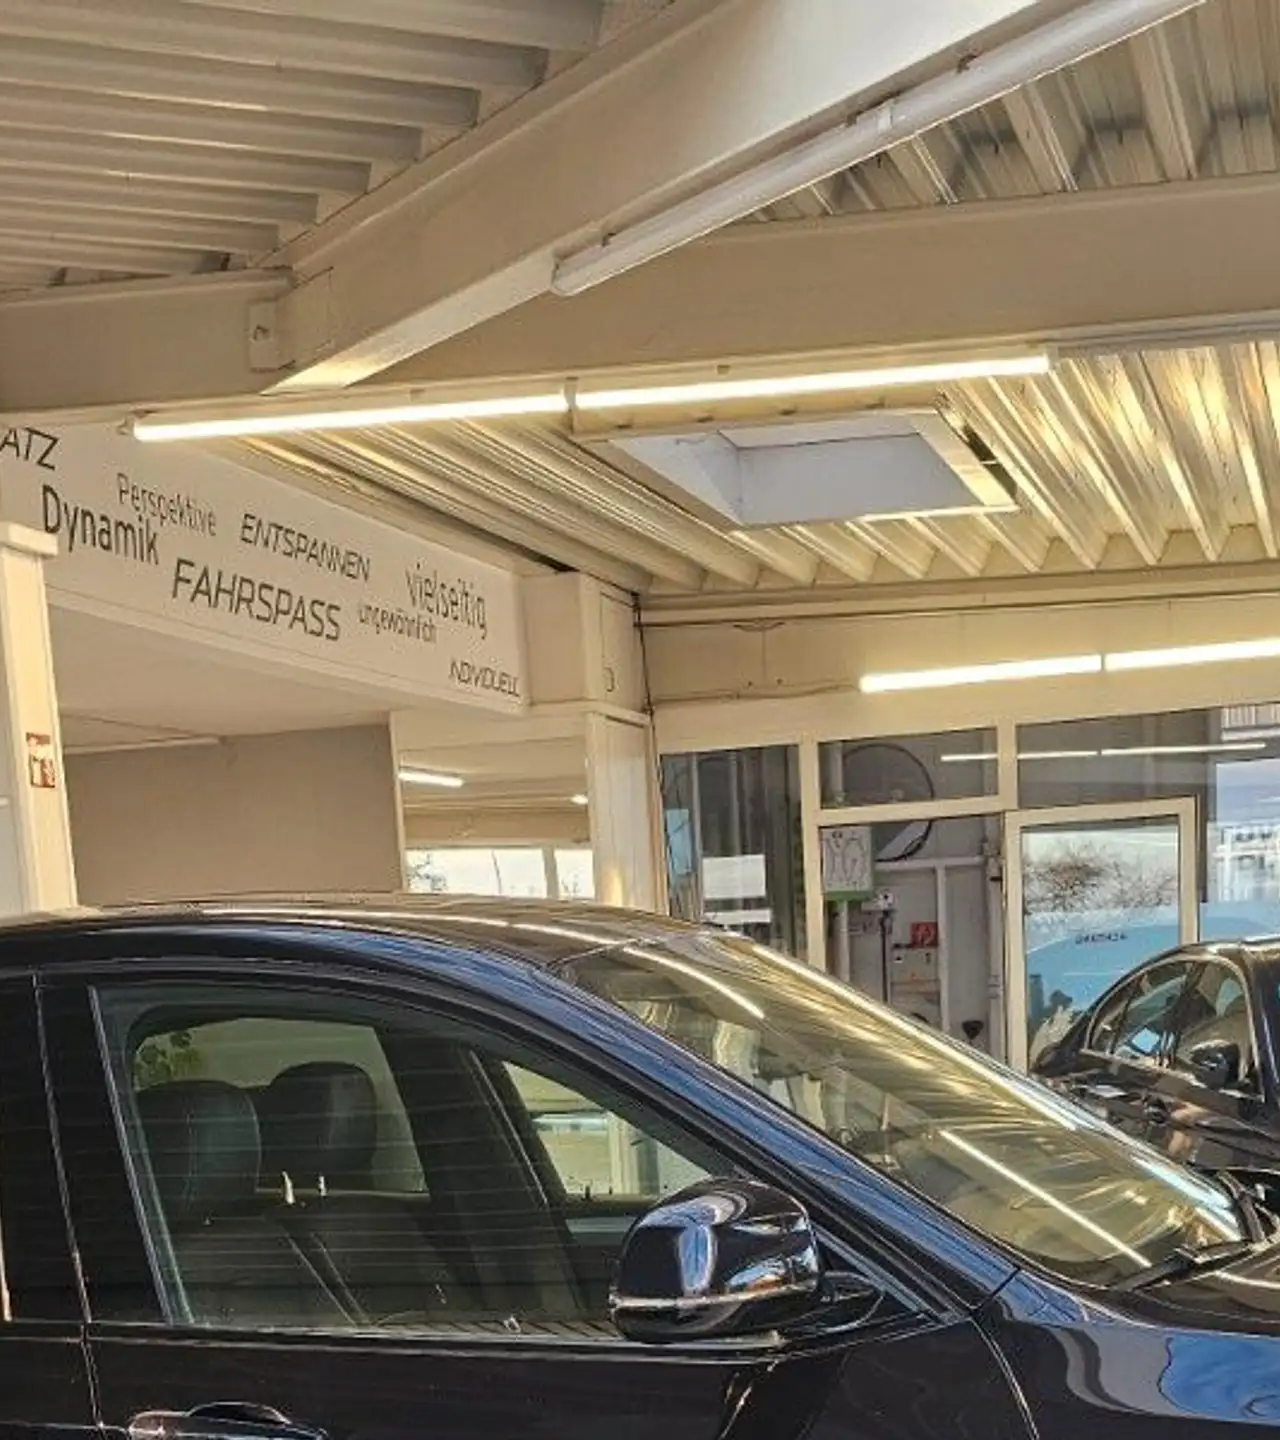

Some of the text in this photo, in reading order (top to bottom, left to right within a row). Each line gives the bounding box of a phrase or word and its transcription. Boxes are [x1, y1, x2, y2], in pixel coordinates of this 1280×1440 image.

[41, 483, 160, 566] Dynamik
[116, 471, 218, 537] Perspektive
[239, 512, 372, 584] ENTSPANNEN
[171, 557, 342, 642] FAHRSPASS
[404, 560, 488, 640] vielseitig
